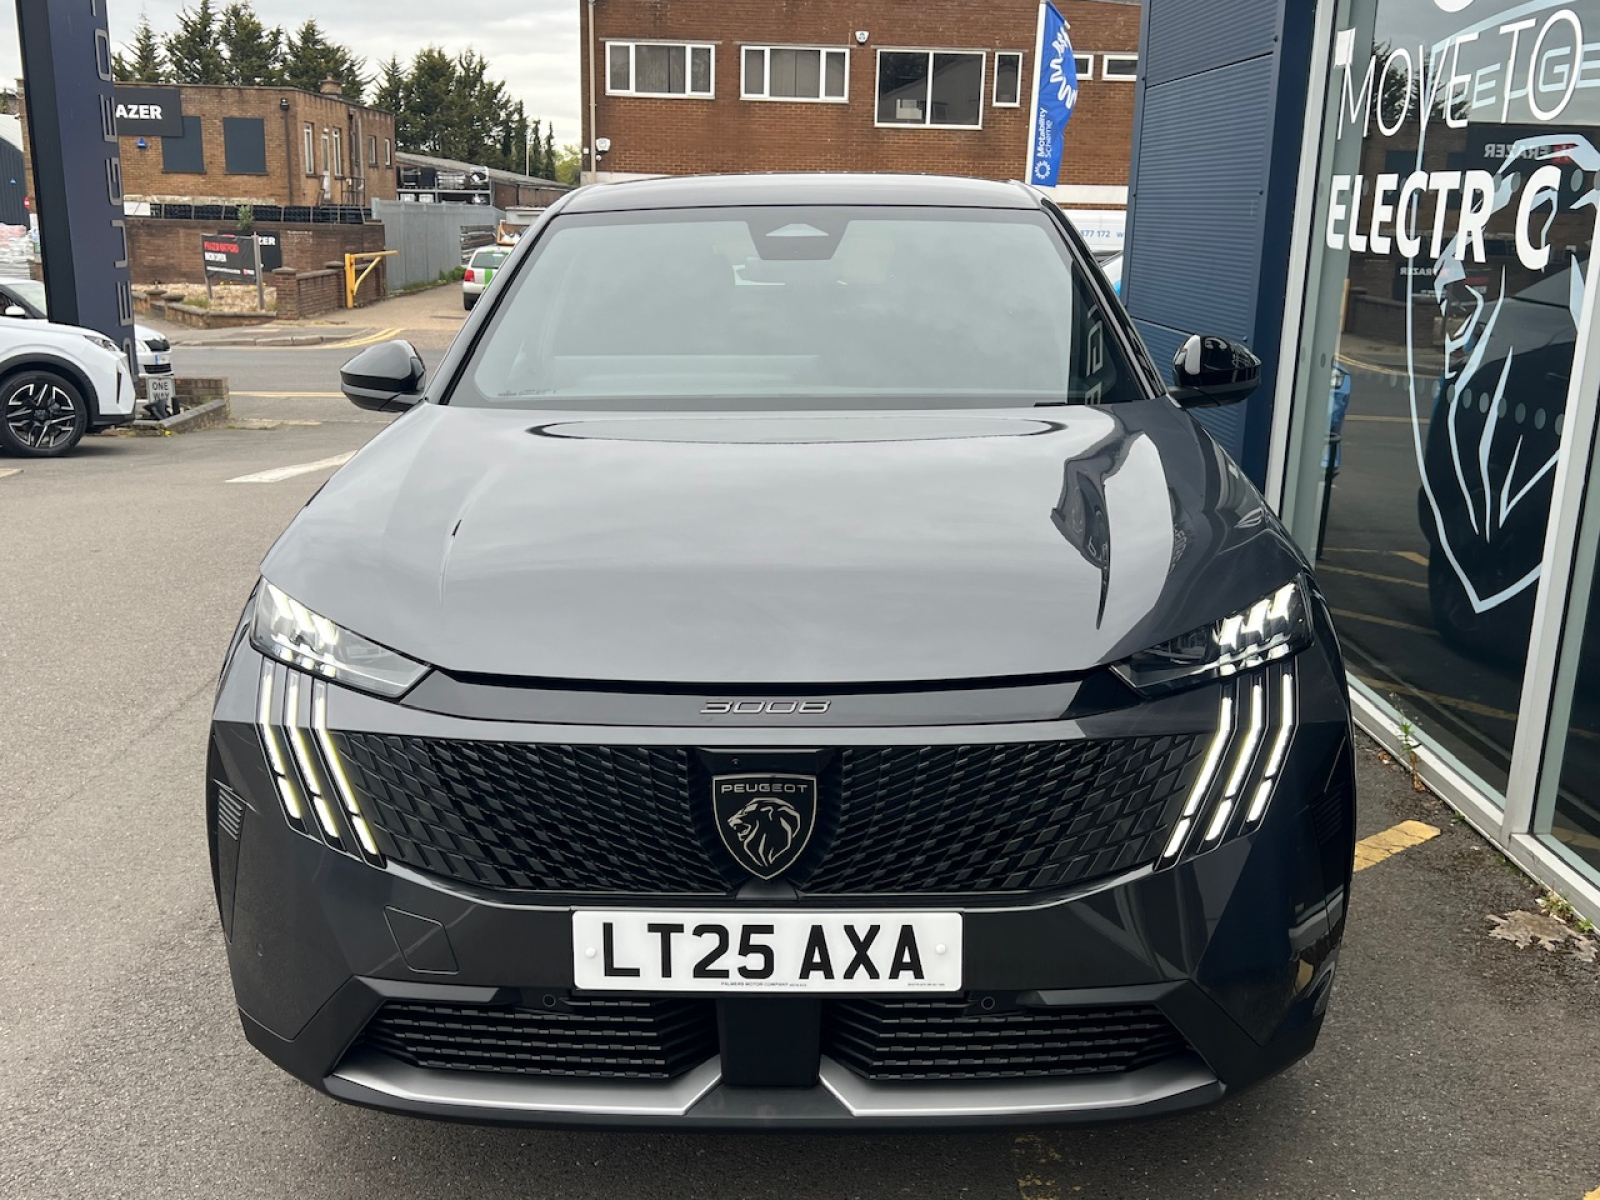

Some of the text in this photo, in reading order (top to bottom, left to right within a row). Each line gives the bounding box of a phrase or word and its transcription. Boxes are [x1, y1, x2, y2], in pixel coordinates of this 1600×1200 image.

[1336, 9, 1583, 140] MOVE TO
[1037, 107, 1048, 157] Motability
[1044, 119, 1053, 158] Scheme
[1096, 230, 1110, 238] 172
[152, 381, 169, 391] ONE
[700, 700, 831, 714] 3008
[721, 783, 808, 794] PEUGEOT
[602, 922, 925, 981] LT25 AXA
